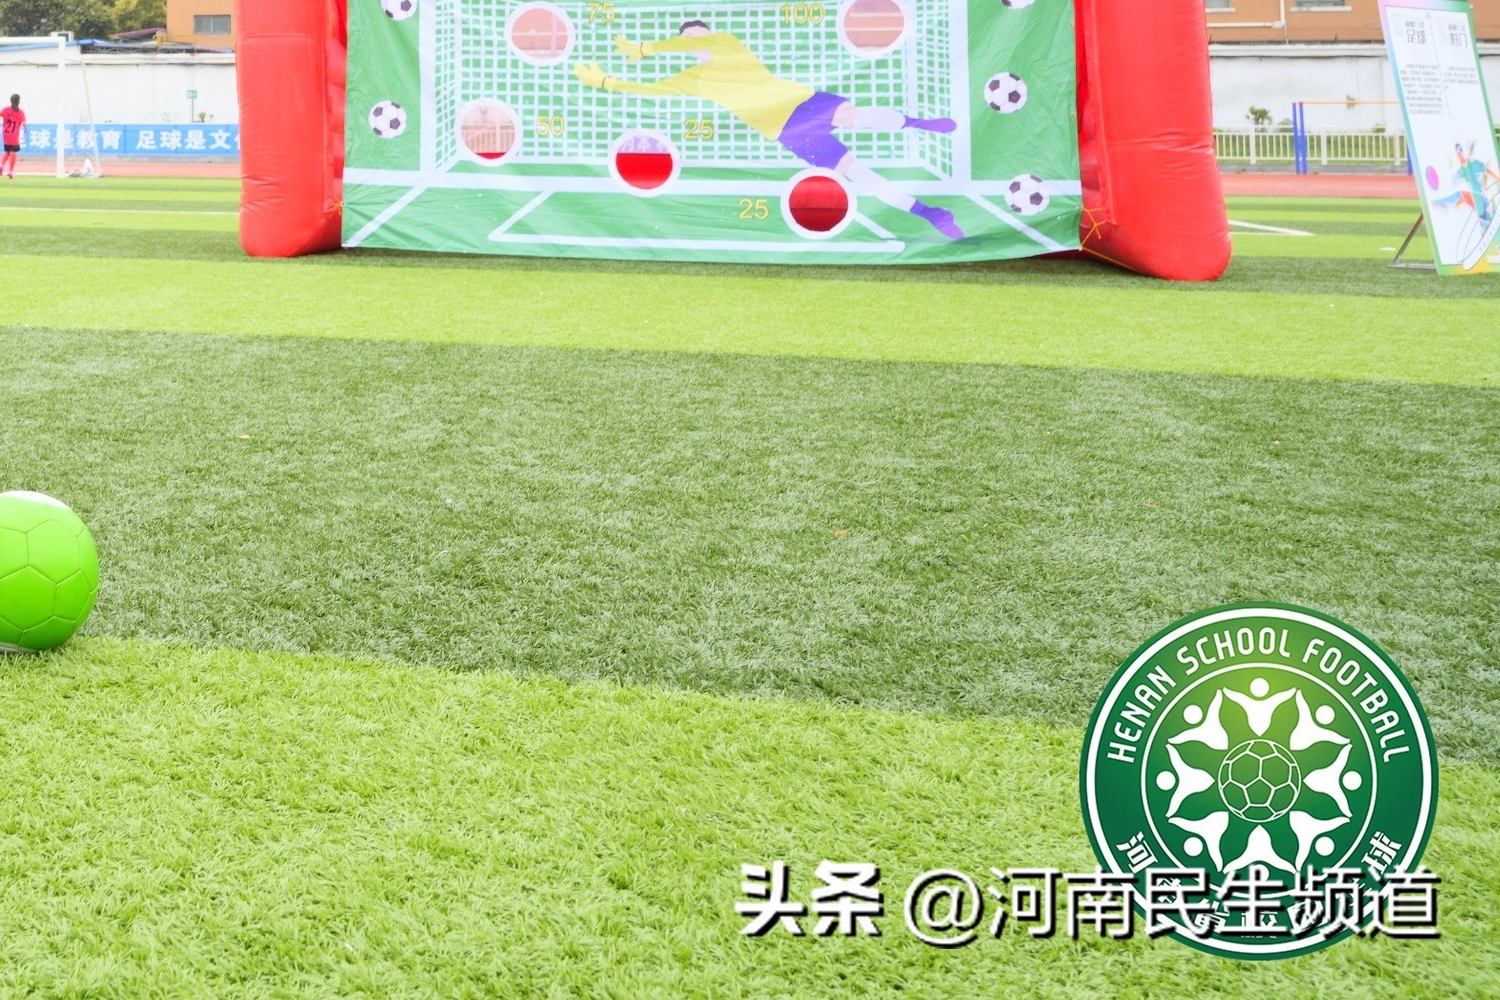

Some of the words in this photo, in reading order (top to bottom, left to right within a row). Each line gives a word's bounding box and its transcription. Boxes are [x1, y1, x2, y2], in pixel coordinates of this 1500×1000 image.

[586, 1, 616, 23] 75
[780, 3, 824, 25] 100
[4, 119, 17, 133] 21
[536, 115, 564, 136] 50
[684, 118, 714, 139] 25
[19, 129, 122, 150] 球是教育
[136, 129, 239, 150] 足球是文
[738, 198, 769, 220] 25
